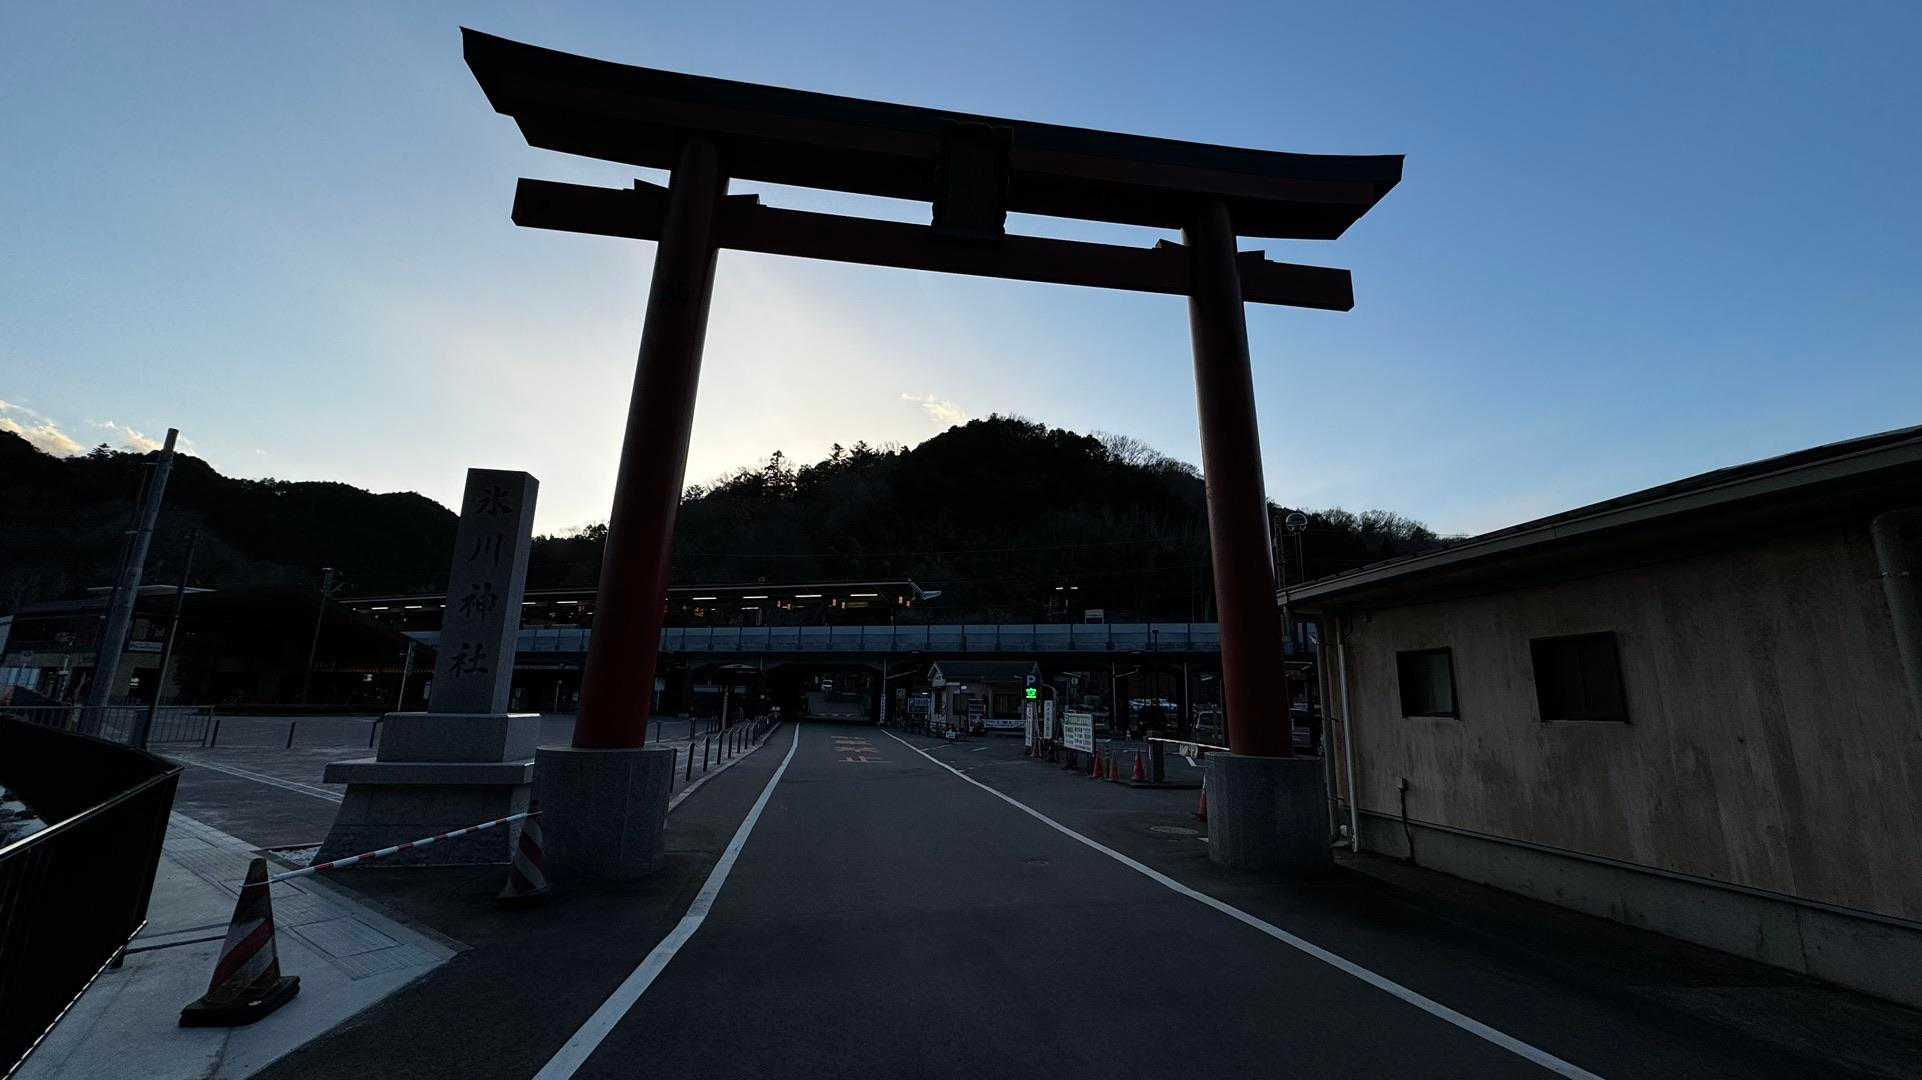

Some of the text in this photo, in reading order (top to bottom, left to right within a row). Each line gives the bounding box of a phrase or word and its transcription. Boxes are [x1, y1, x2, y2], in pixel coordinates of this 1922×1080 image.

[450, 485, 513, 677] 氷川神社
[1026, 675, 1036, 686] P
